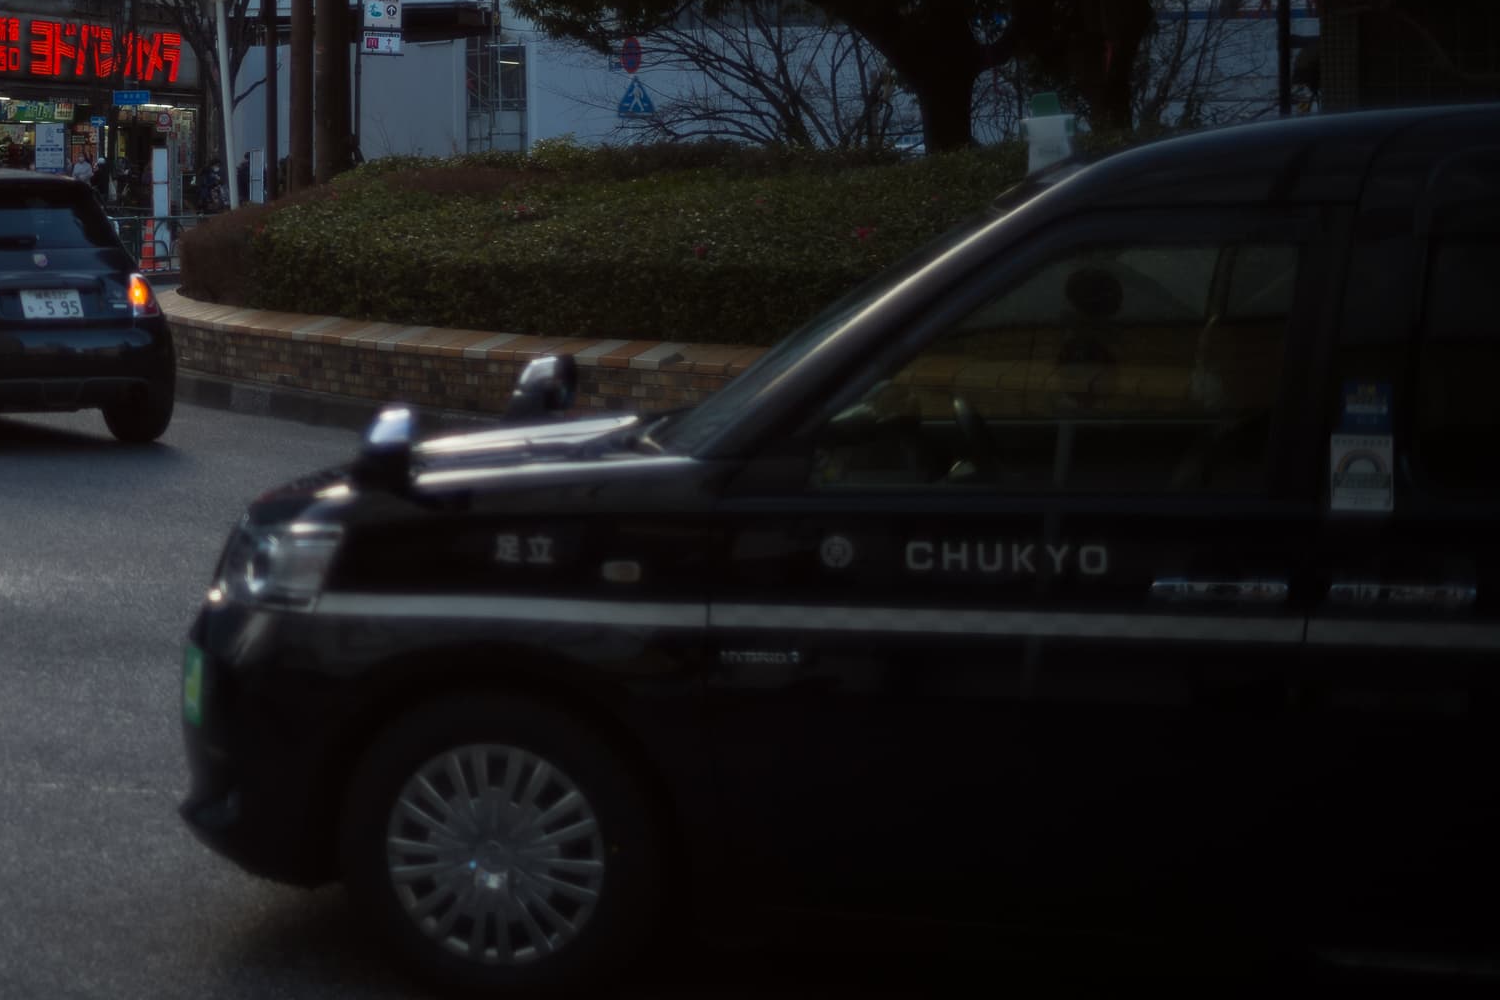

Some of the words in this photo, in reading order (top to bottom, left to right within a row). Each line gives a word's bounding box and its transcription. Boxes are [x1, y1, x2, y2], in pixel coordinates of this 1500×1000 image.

[29, 20, 181, 83] ヨドバシカメラ
[494, 533, 554, 564] 足立
[904, 540, 1109, 576] CHUKYO
